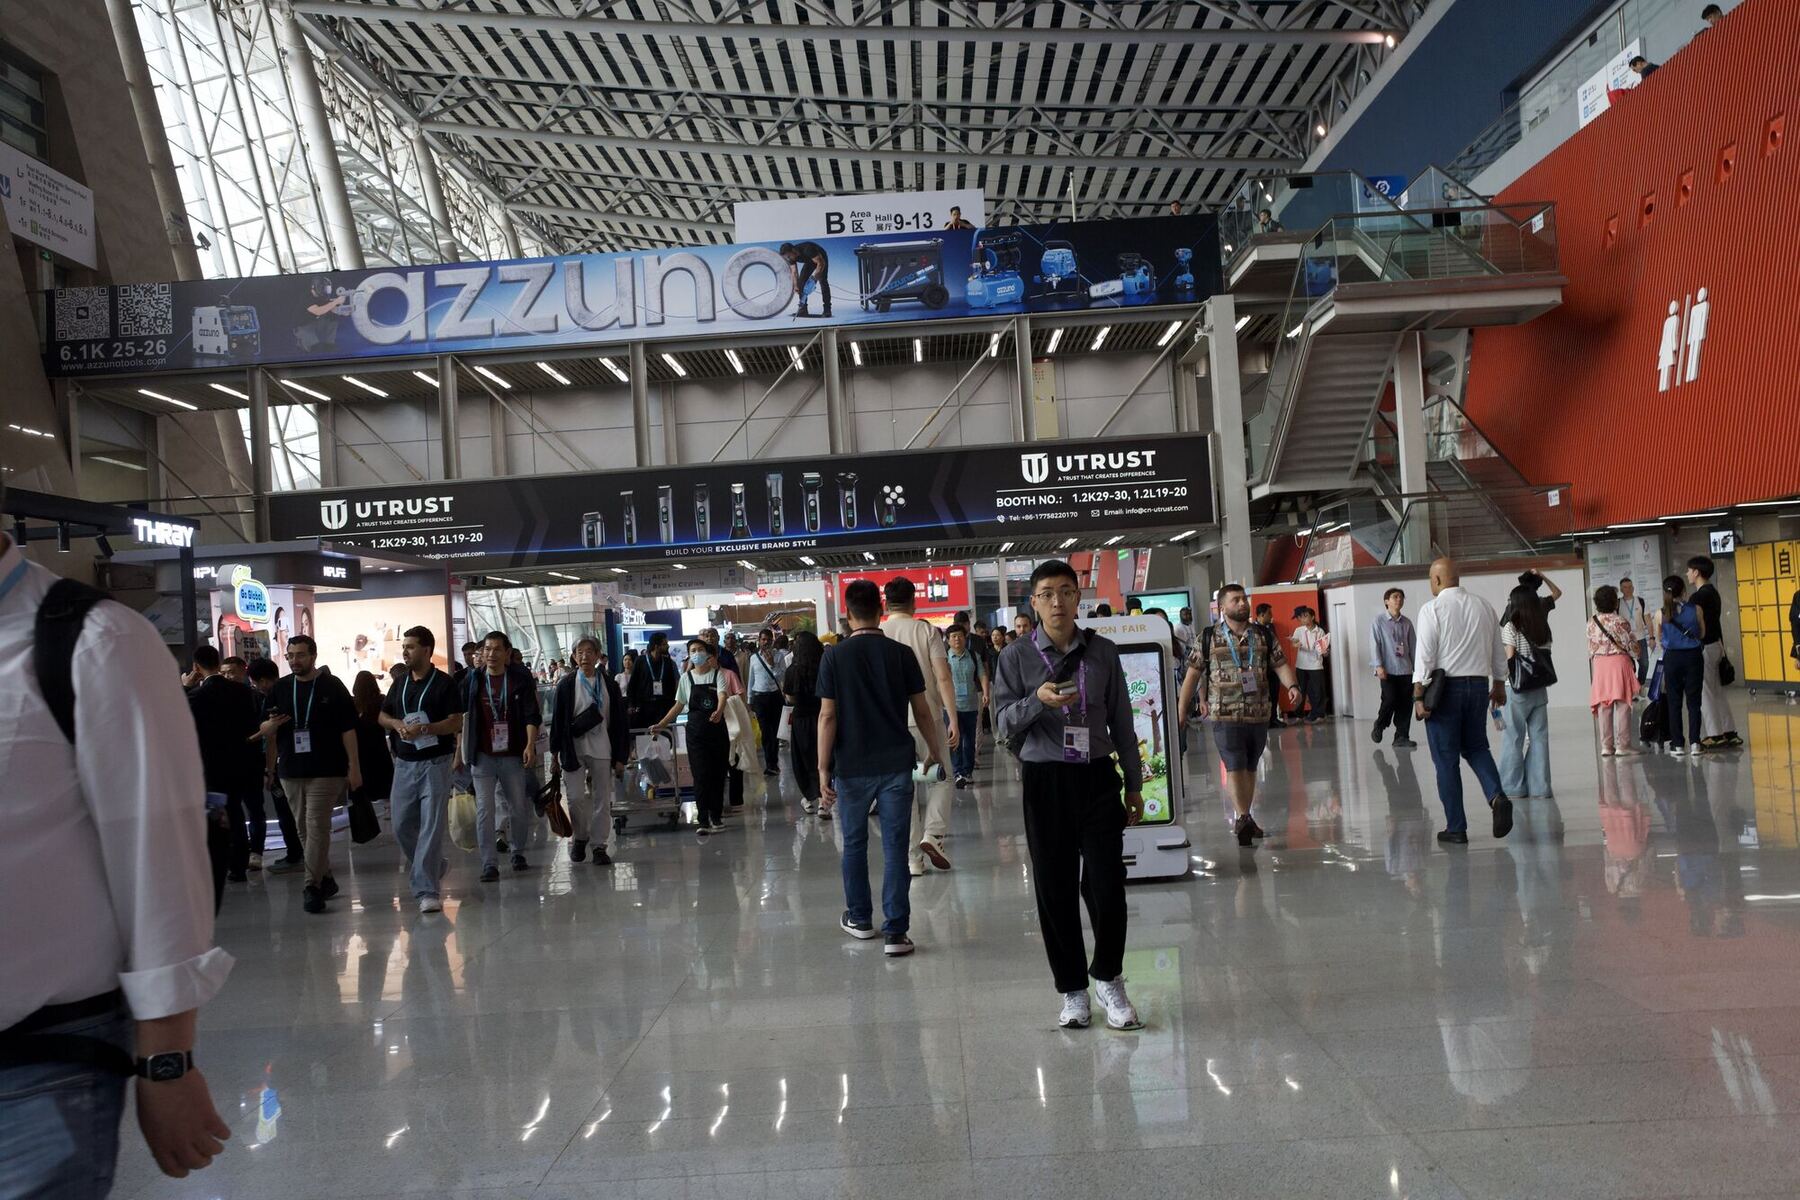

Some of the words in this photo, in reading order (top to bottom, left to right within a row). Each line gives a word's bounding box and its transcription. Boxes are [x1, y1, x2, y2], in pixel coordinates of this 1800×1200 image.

[825, 212, 846, 235] B
[850, 210, 871, 218] Area
[875, 214, 892, 222] Hall
[893, 211, 933, 231] 9-13
[851, 220, 865, 232] 区
[876, 223, 892, 231] 展厅
[351, 247, 795, 345] azzuno
[60, 343, 106, 361] 6.1K
[112, 340, 167, 357] 25-26
[61, 357, 167, 371] www.azzunotools.com
[1056, 450, 1156, 472] UTRUST
[355, 496, 453, 518] UTRUST
[996, 496, 1036, 508] BOOTH
[1039, 494, 1062, 505] NO.:
[1072, 490, 1130, 503] 1.2K29-30,
[1133, 487, 1187, 499] 1.2L19-20
[1125, 505, 1188, 514] info@cn-utrust.com
[370, 536, 428, 549] 1.2K29-30,
[430, 532, 483, 545] 1.2L19-20
[665, 548, 689, 556] BUILD
[691, 546, 713, 554] YOUR
[715, 543, 760, 552] EXCLUSIVE
[762, 541, 790, 549] BRAND
[1778, 548, 1792, 575] 自
[1122, 623, 1147, 633] FAIR
